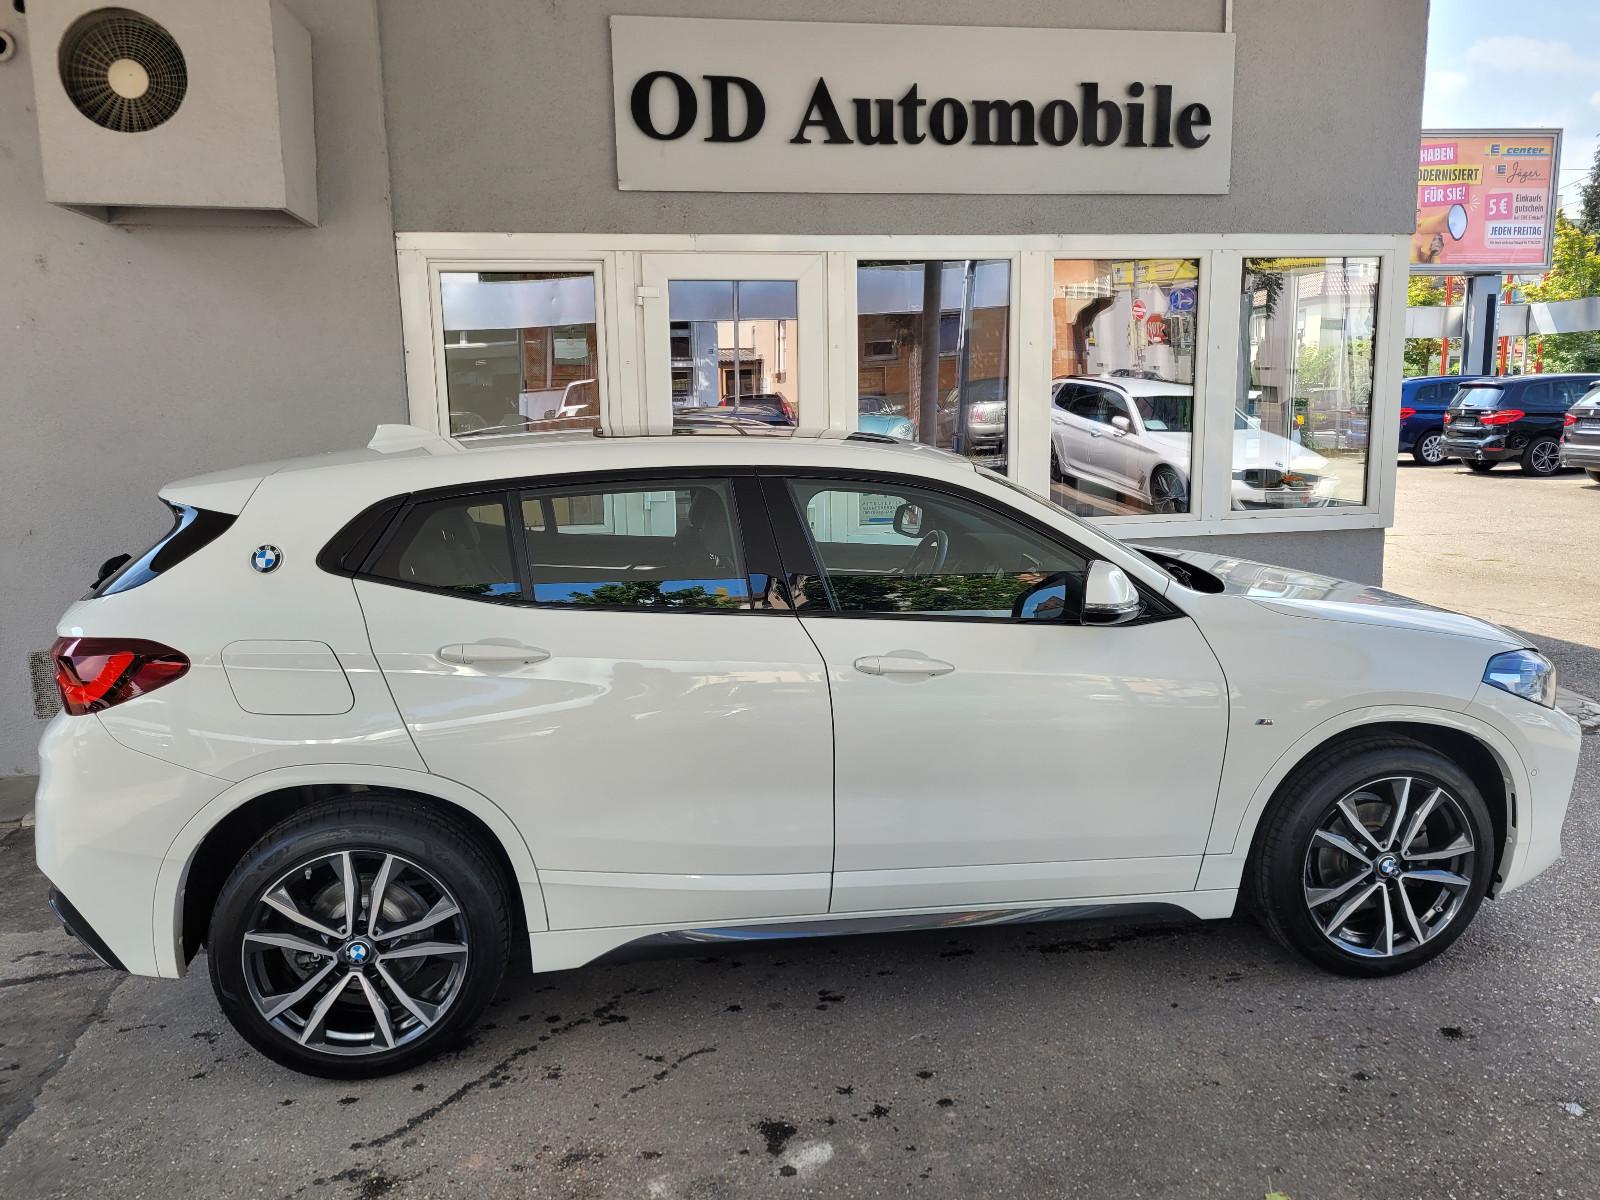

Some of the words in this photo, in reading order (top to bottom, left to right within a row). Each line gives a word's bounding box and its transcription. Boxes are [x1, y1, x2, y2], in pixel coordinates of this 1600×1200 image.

[630, 71, 766, 142] OD
[789, 76, 1212, 150] Automobile
[1420, 147, 1454, 162] HABEN
[1507, 161, 1541, 183] Jäger
[1424, 187, 1444, 203] FÜR
[1447, 186, 1465, 201] SIE!
[1515, 194, 1542, 203] Einkaufs
[1488, 198, 1497, 215] 5
[1499, 197, 1508, 214] €
[1514, 204, 1544, 213] gutschein
[1490, 226, 1512, 236] JEDEN
[1513, 226, 1542, 236] FREITAG
